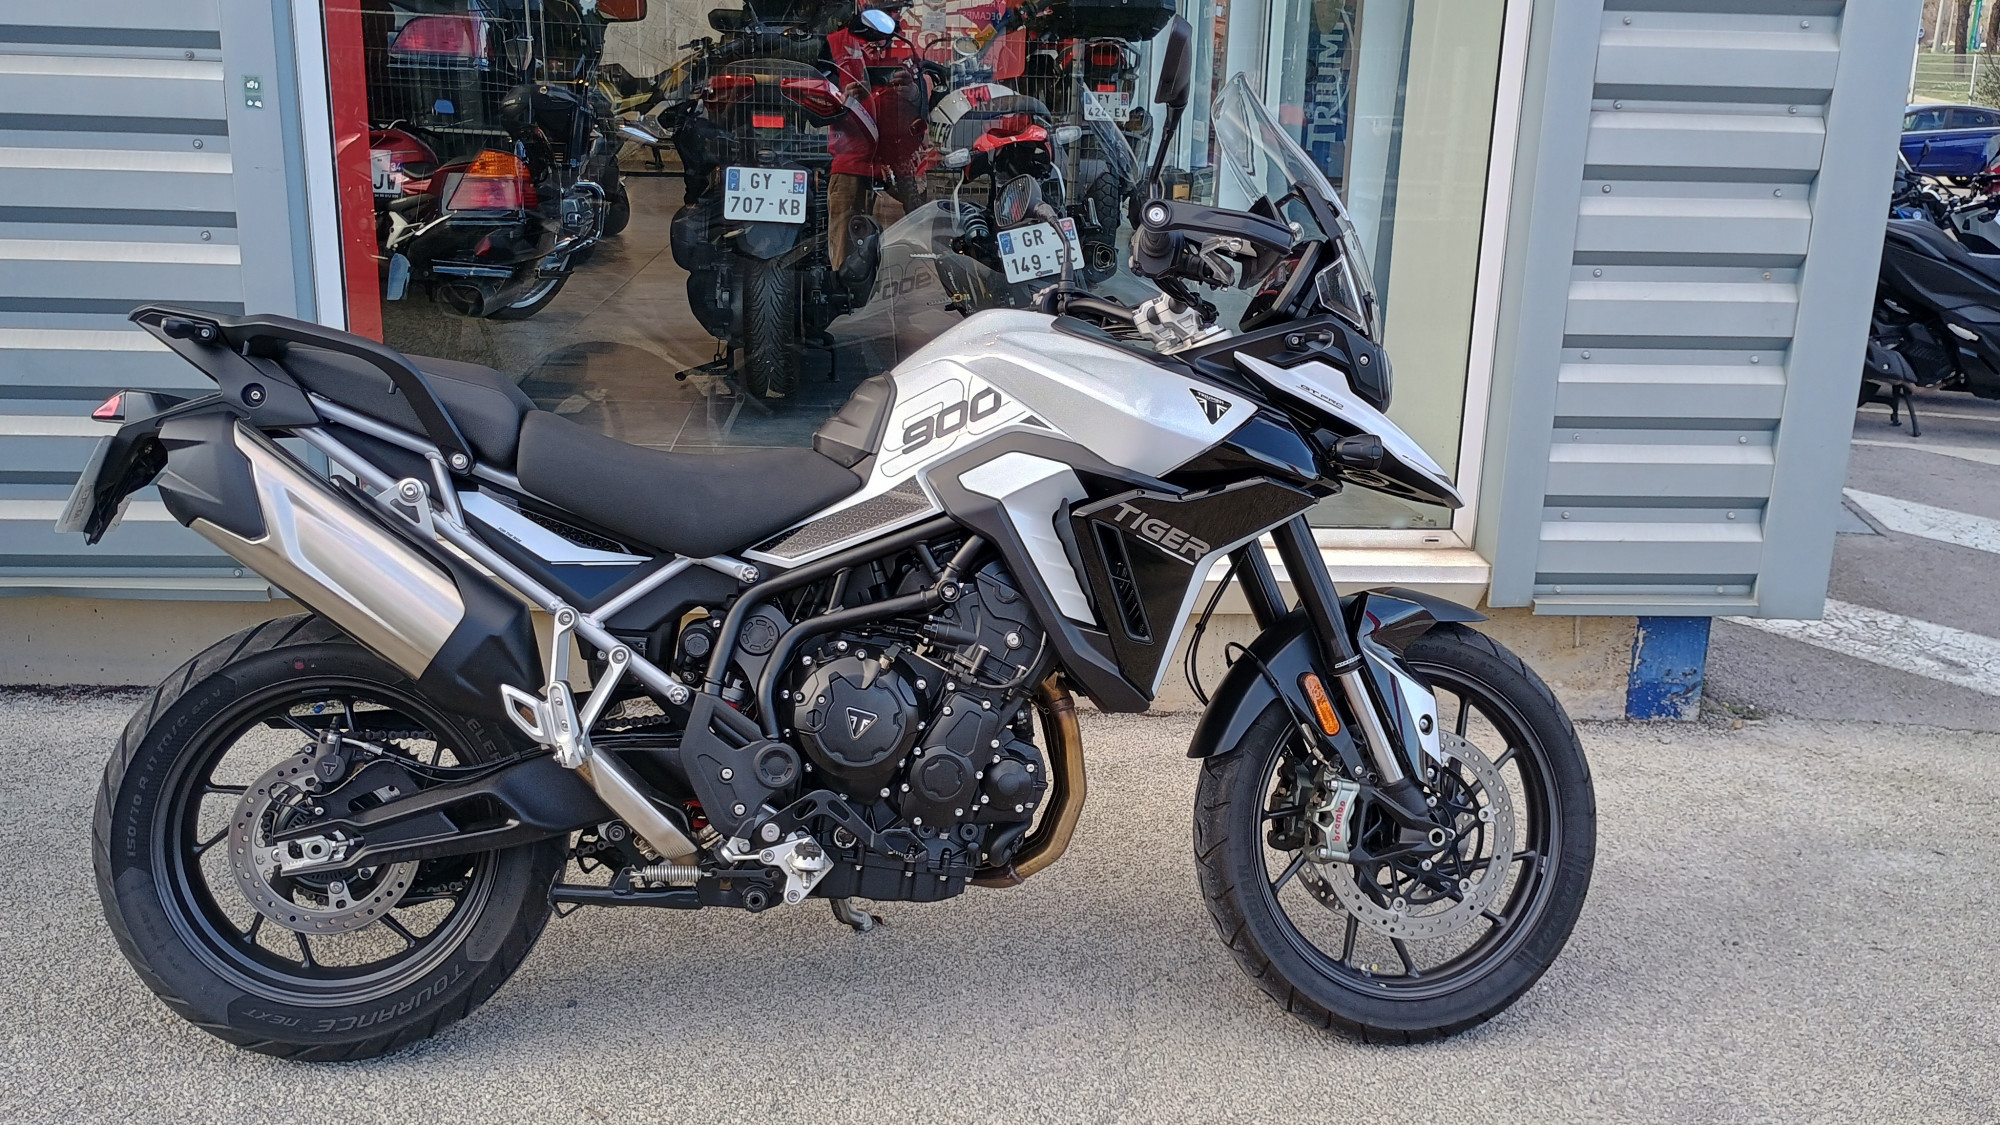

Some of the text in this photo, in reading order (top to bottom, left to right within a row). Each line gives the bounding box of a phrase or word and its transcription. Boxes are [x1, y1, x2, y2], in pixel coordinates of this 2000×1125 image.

[730, 196, 801, 216] 707-KB
[793, 183, 804, 193] 34
[1300, 384, 1345, 409] GT PRO
[902, 386, 1002, 455] 900
[1114, 502, 1211, 561] TIGER
[1332, 800, 1346, 843] brembo
[311, 963, 466, 1033] TOURANCE
